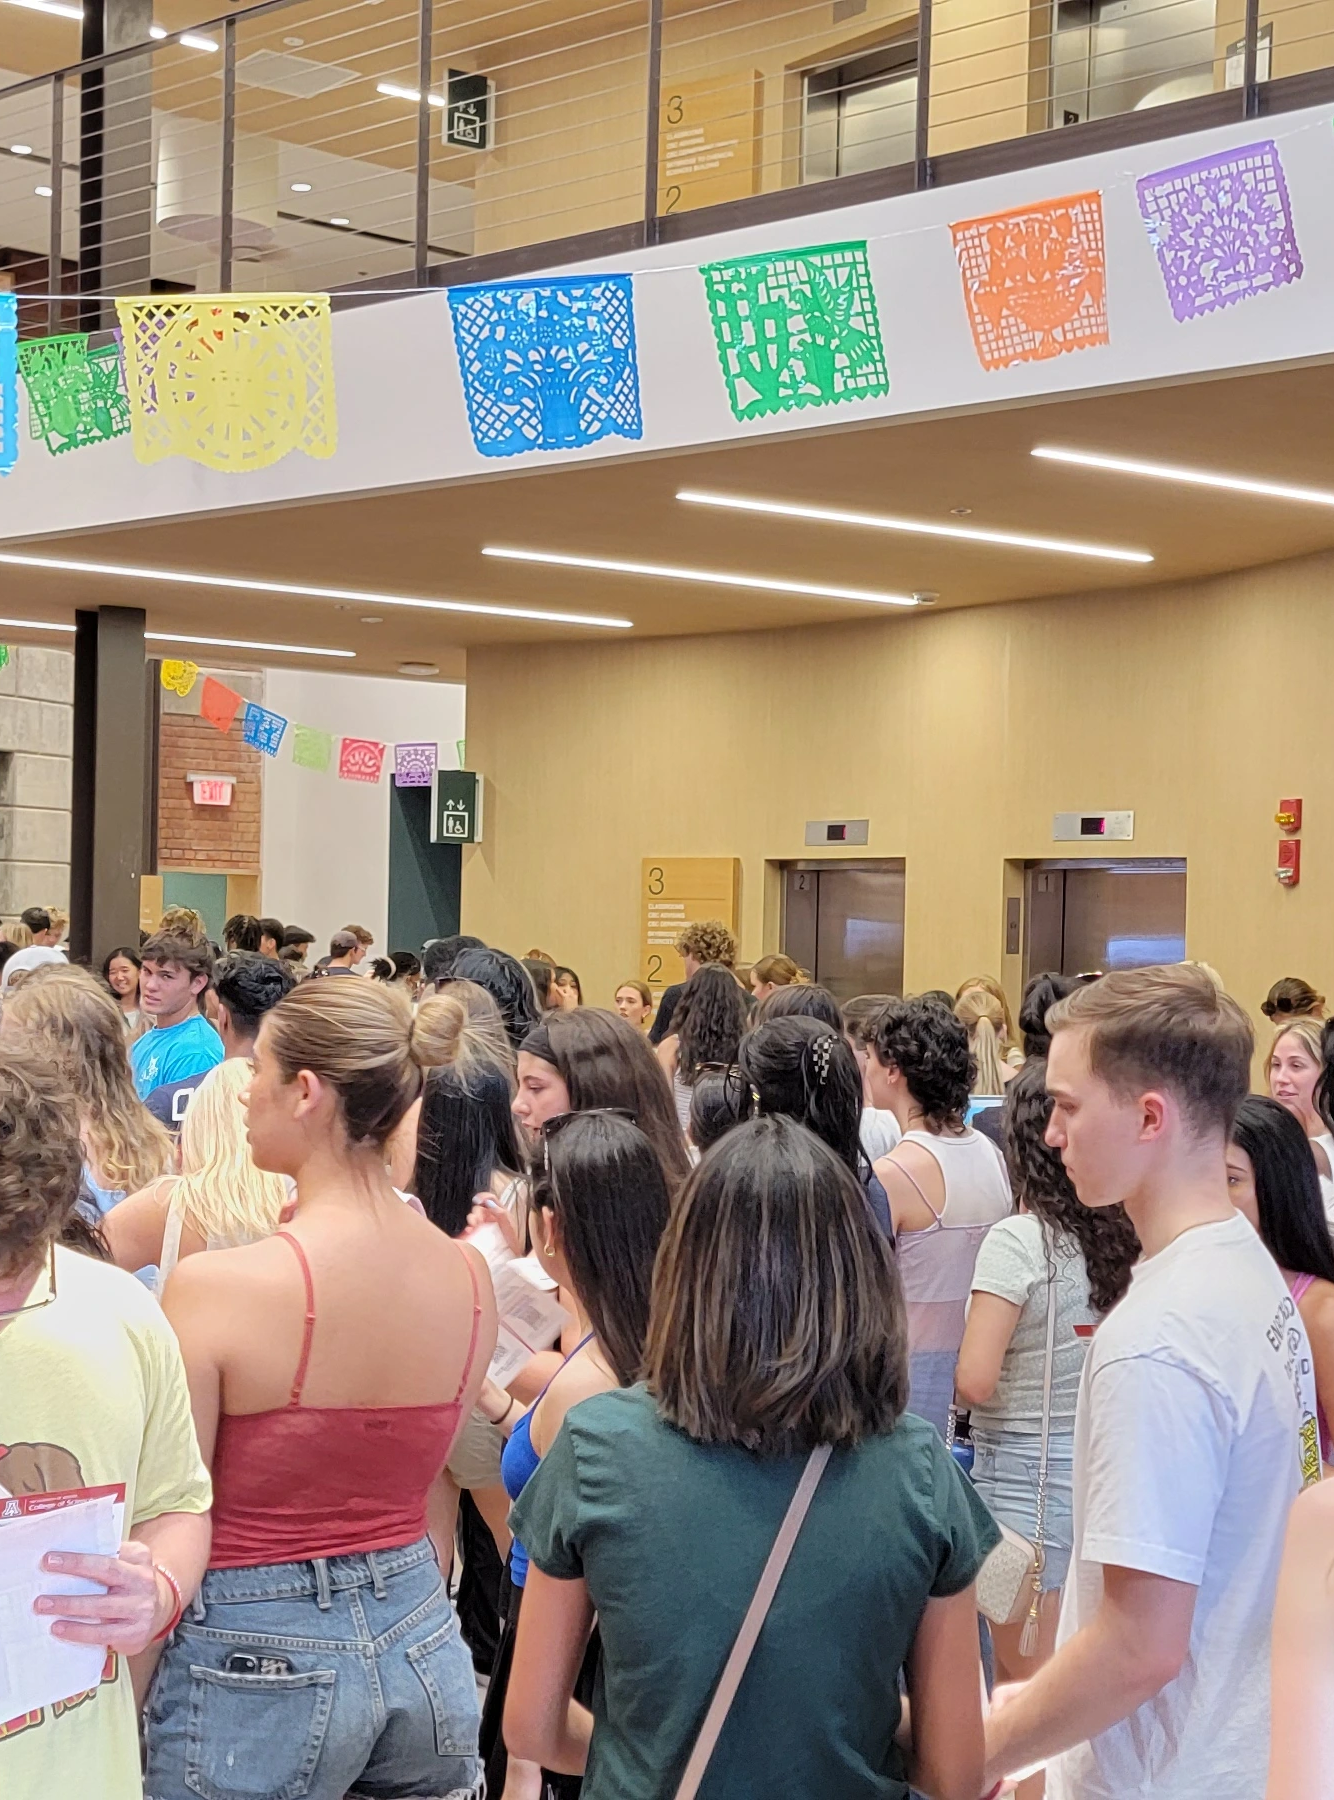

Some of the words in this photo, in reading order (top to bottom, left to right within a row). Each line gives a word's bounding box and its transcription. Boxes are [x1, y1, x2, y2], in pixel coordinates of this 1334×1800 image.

[667, 95, 683, 124] 3
[666, 186, 681, 214] 2
[648, 867, 664, 895] 3
[799, 874, 805, 890] 2
[647, 955, 662, 982] 2
